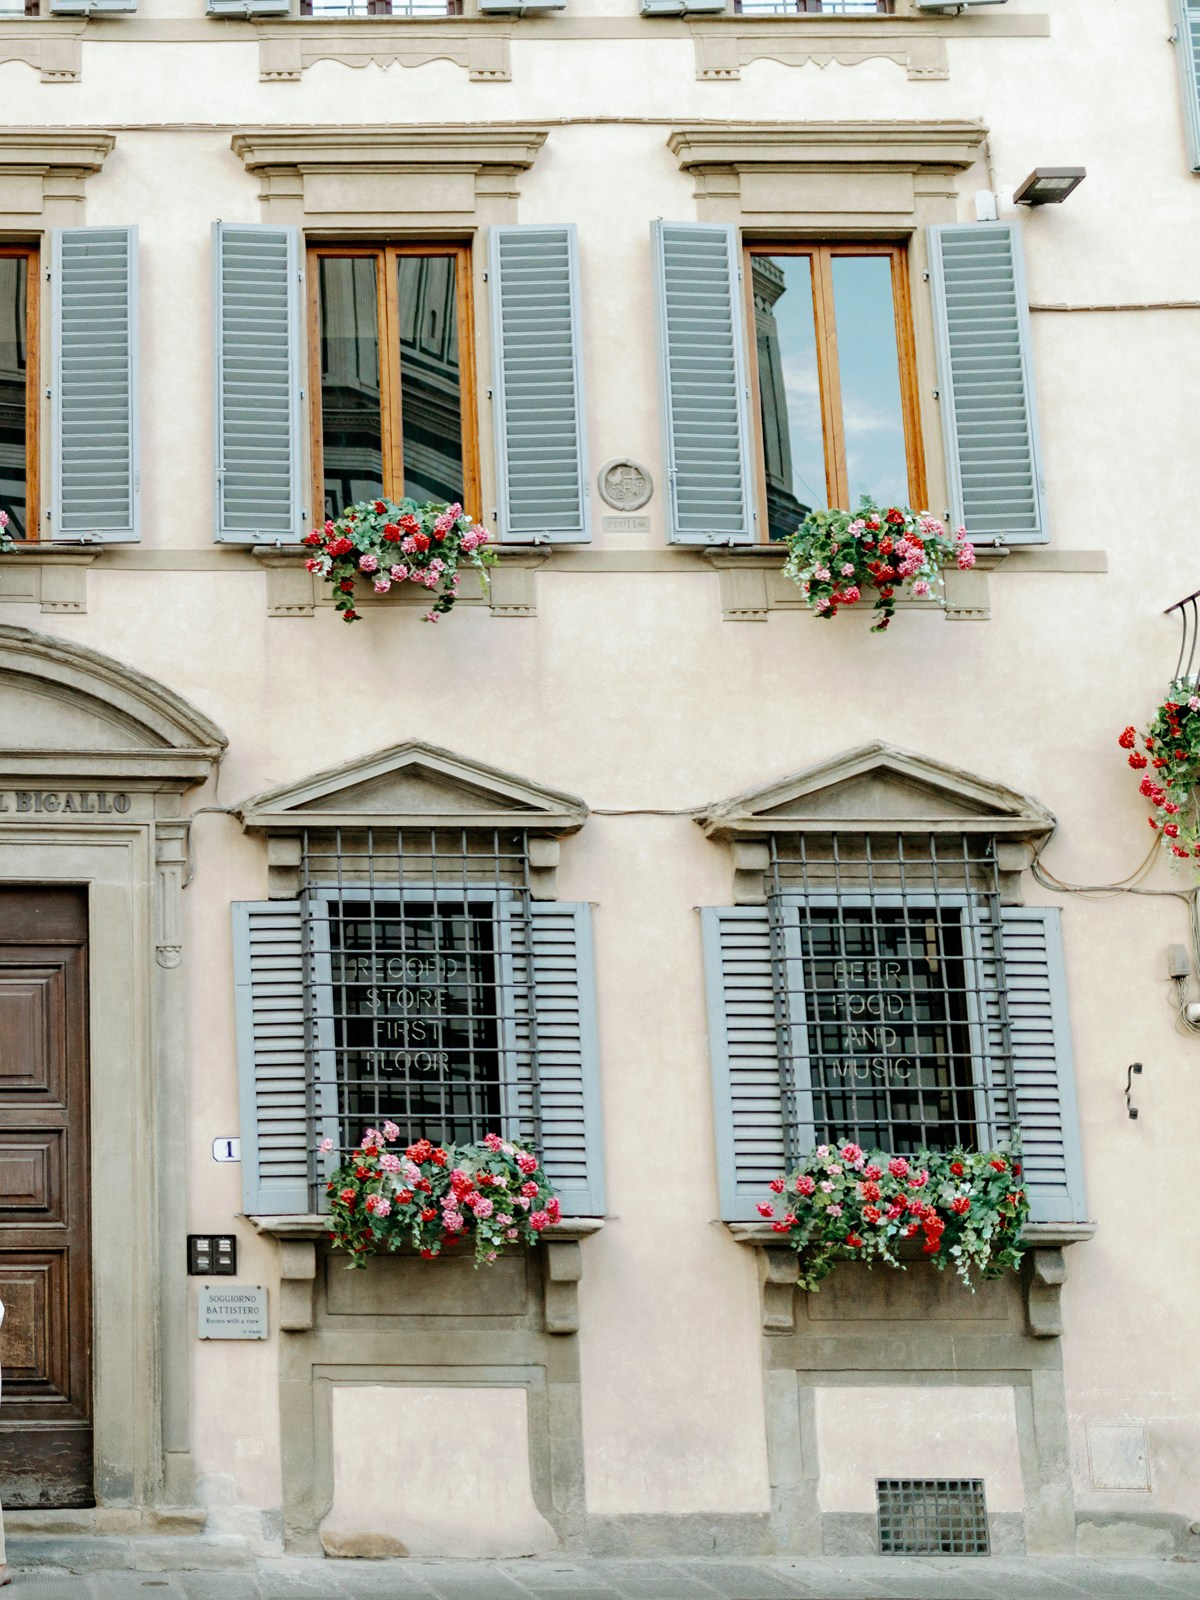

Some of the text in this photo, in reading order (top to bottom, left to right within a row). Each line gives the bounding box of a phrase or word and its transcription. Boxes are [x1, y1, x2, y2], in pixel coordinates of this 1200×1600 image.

[15, 792, 132, 814] BIGALLO
[355, 957, 457, 978] RECORD
[366, 989, 448, 1010] STORE
[832, 994, 904, 1015] FOOD
[375, 1020, 440, 1041] FIRST
[845, 1027, 897, 1047] AND
[366, 1051, 450, 1072] FLOOR
[832, 1058, 911, 1079] MUSIC
[225, 1141, 235, 1158] 1
[209, 1295, 256, 1303] SOGGIORNO
[206, 1306, 259, 1315] BATTISTERO
